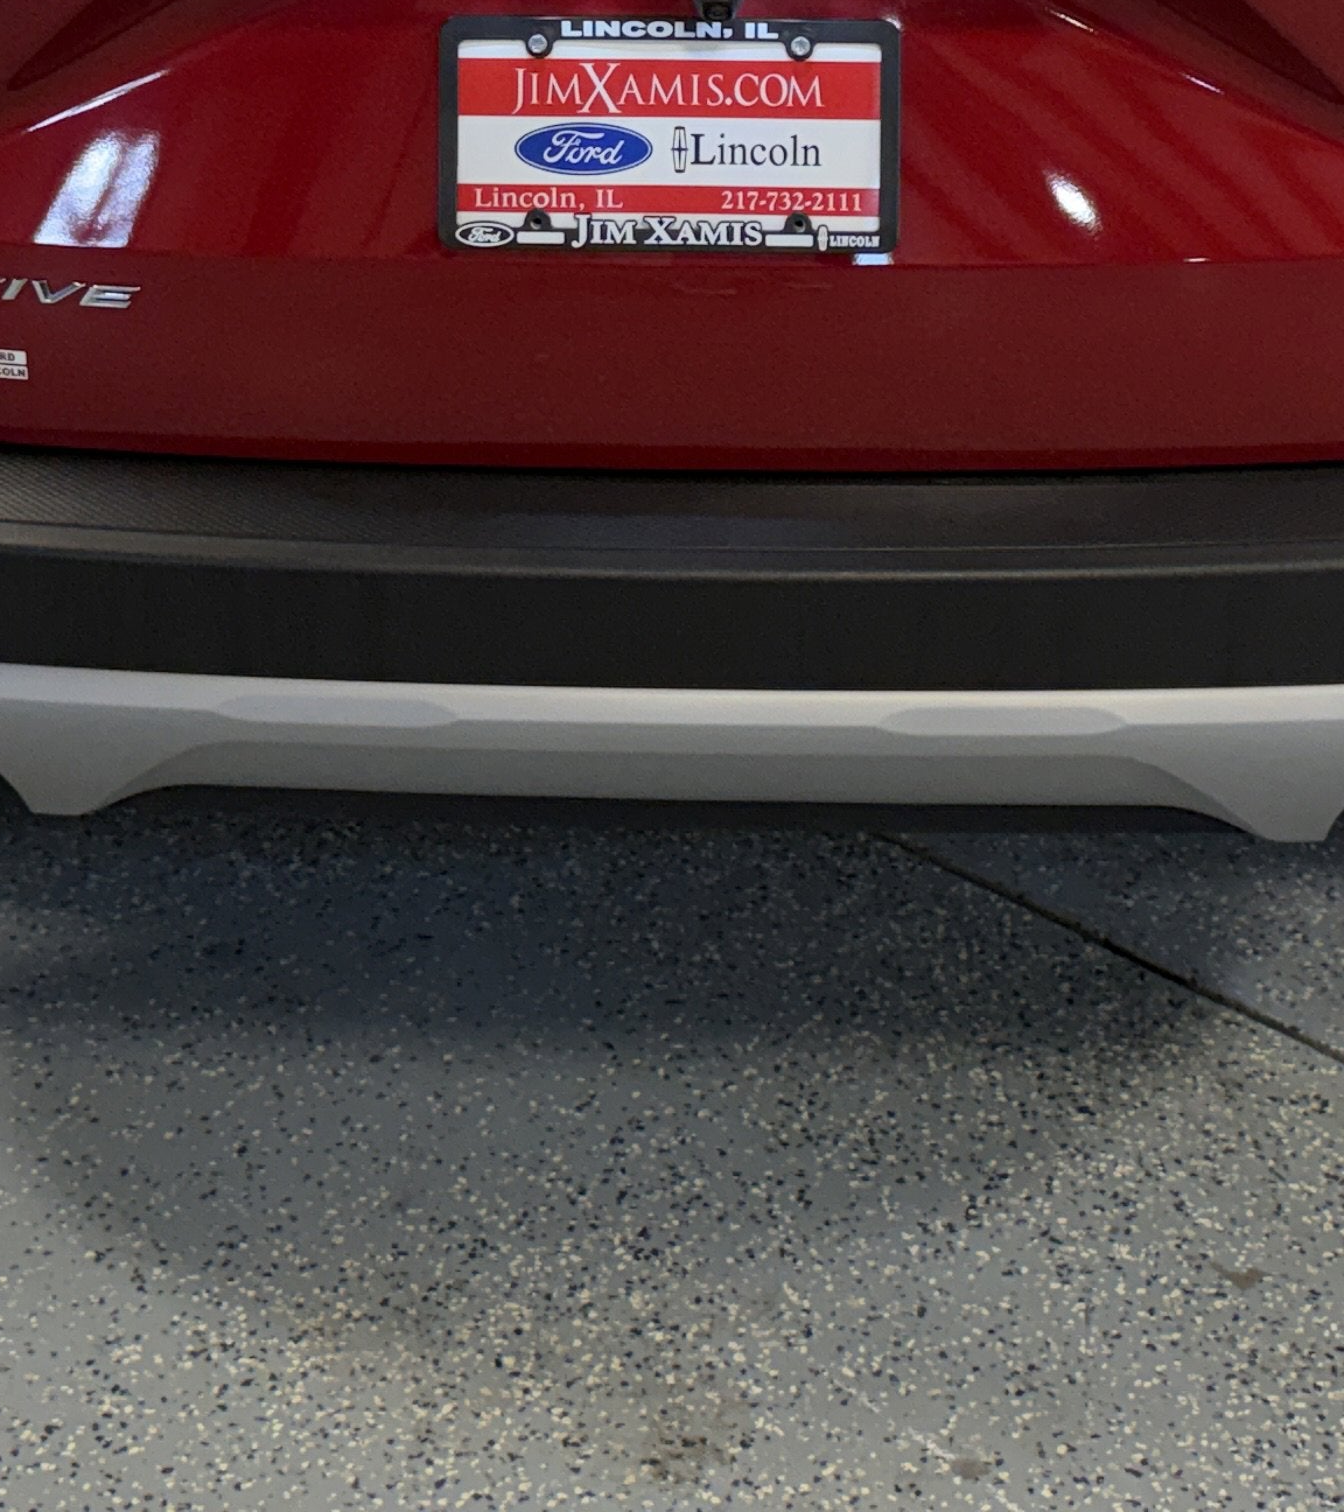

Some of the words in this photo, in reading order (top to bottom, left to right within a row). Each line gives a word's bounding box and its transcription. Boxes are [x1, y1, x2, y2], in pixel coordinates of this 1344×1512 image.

[560, 20, 733, 40] LINCOLN,
[744, 21, 779, 40] IL
[512, 62, 825, 115] JIMXAMIS.COM
[542, 129, 624, 166] Ford
[690, 133, 823, 168] Lincoln
[473, 187, 586, 211] Lincoln,
[595, 189, 624, 209] IL
[720, 190, 863, 212] 217-732-2111
[468, 226, 503, 243] Ford
[572, 214, 640, 249] JIM
[643, 215, 763, 247] XAMIS
[829, 234, 880, 248] LINCOLN
